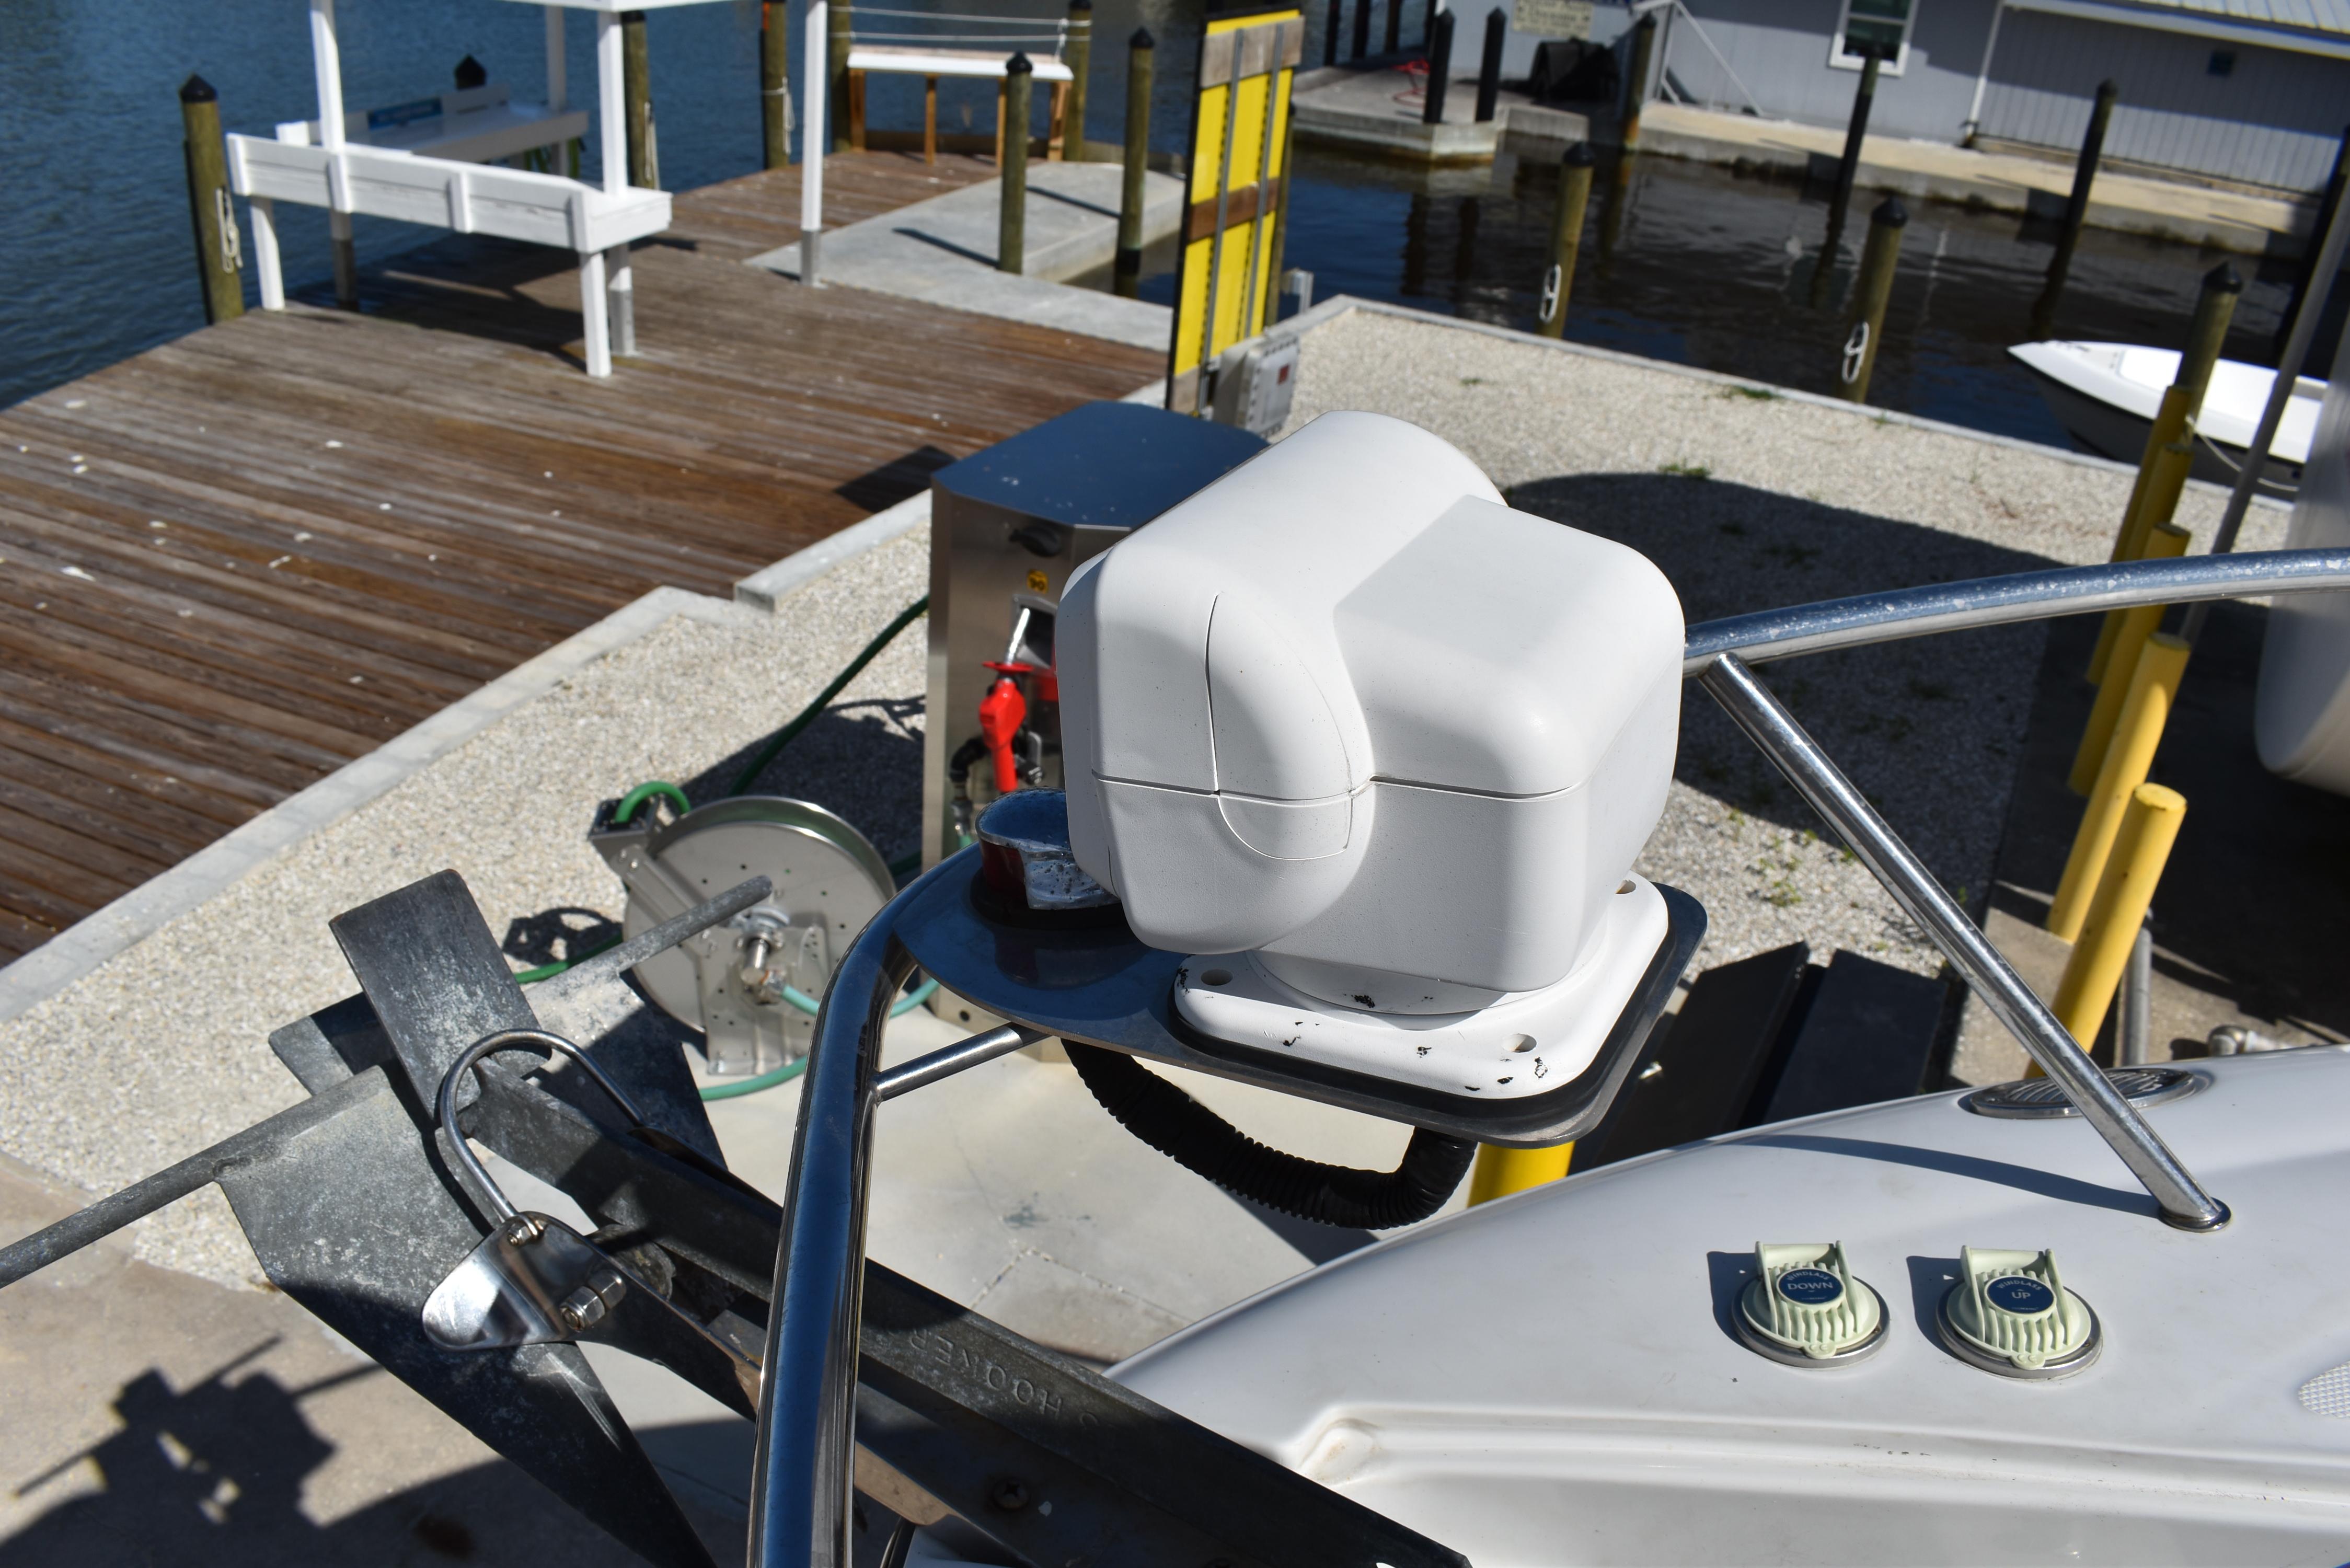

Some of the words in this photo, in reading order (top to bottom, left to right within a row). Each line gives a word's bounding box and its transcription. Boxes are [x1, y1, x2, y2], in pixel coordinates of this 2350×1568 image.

[1787, 1271, 1830, 1281] WINDLASS
[1788, 1282, 1834, 1290] DOWN
[1997, 1279, 2042, 1290] WINDLASS
